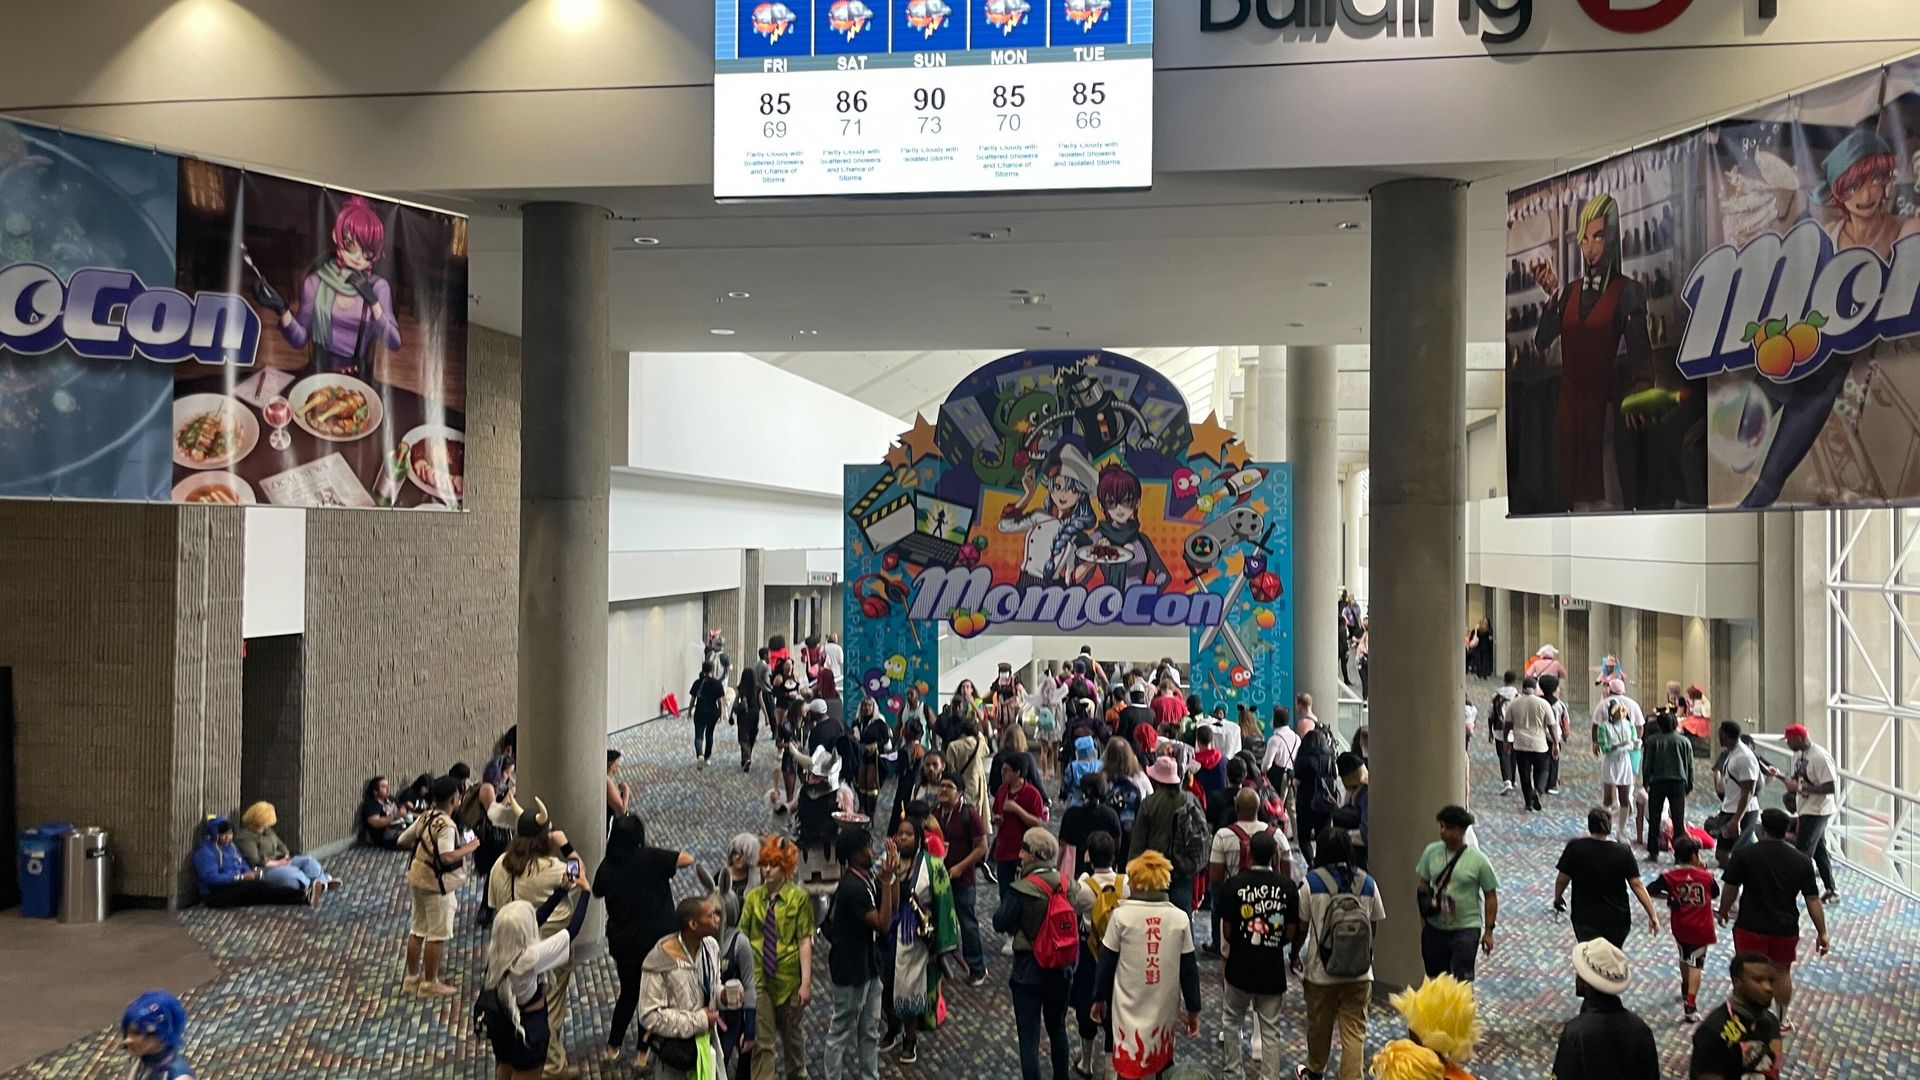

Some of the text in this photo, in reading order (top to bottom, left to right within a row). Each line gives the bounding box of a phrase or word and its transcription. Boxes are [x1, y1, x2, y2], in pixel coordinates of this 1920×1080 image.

[837, 55, 868, 71] SAT
[913, 52, 947, 68] SUN
[990, 49, 1028, 65] MON
[1073, 46, 1106, 62] TUE
[763, 58, 788, 73] FRI
[836, 90, 868, 113] 86
[913, 87, 946, 110] 90
[992, 85, 1025, 108] 85
[1072, 82, 1106, 105] 85
[760, 93, 791, 115] 85
[763, 121, 787, 138] 69
[840, 118, 862, 136] 71
[918, 116, 942, 134] 73
[996, 113, 1021, 131] 70
[1076, 111, 1101, 129] 66
[1273, 468, 1287, 546] COSPLAY
[908, 566, 1224, 632] MomoCon
[846, 594, 860, 675] JAPANESE
[1191, 663, 1203, 696] NGA
[1251, 644, 1266, 705] GAMES
[1237, 885, 1280, 902] Take it
[1145, 917, 1162, 985] 四代目火影
